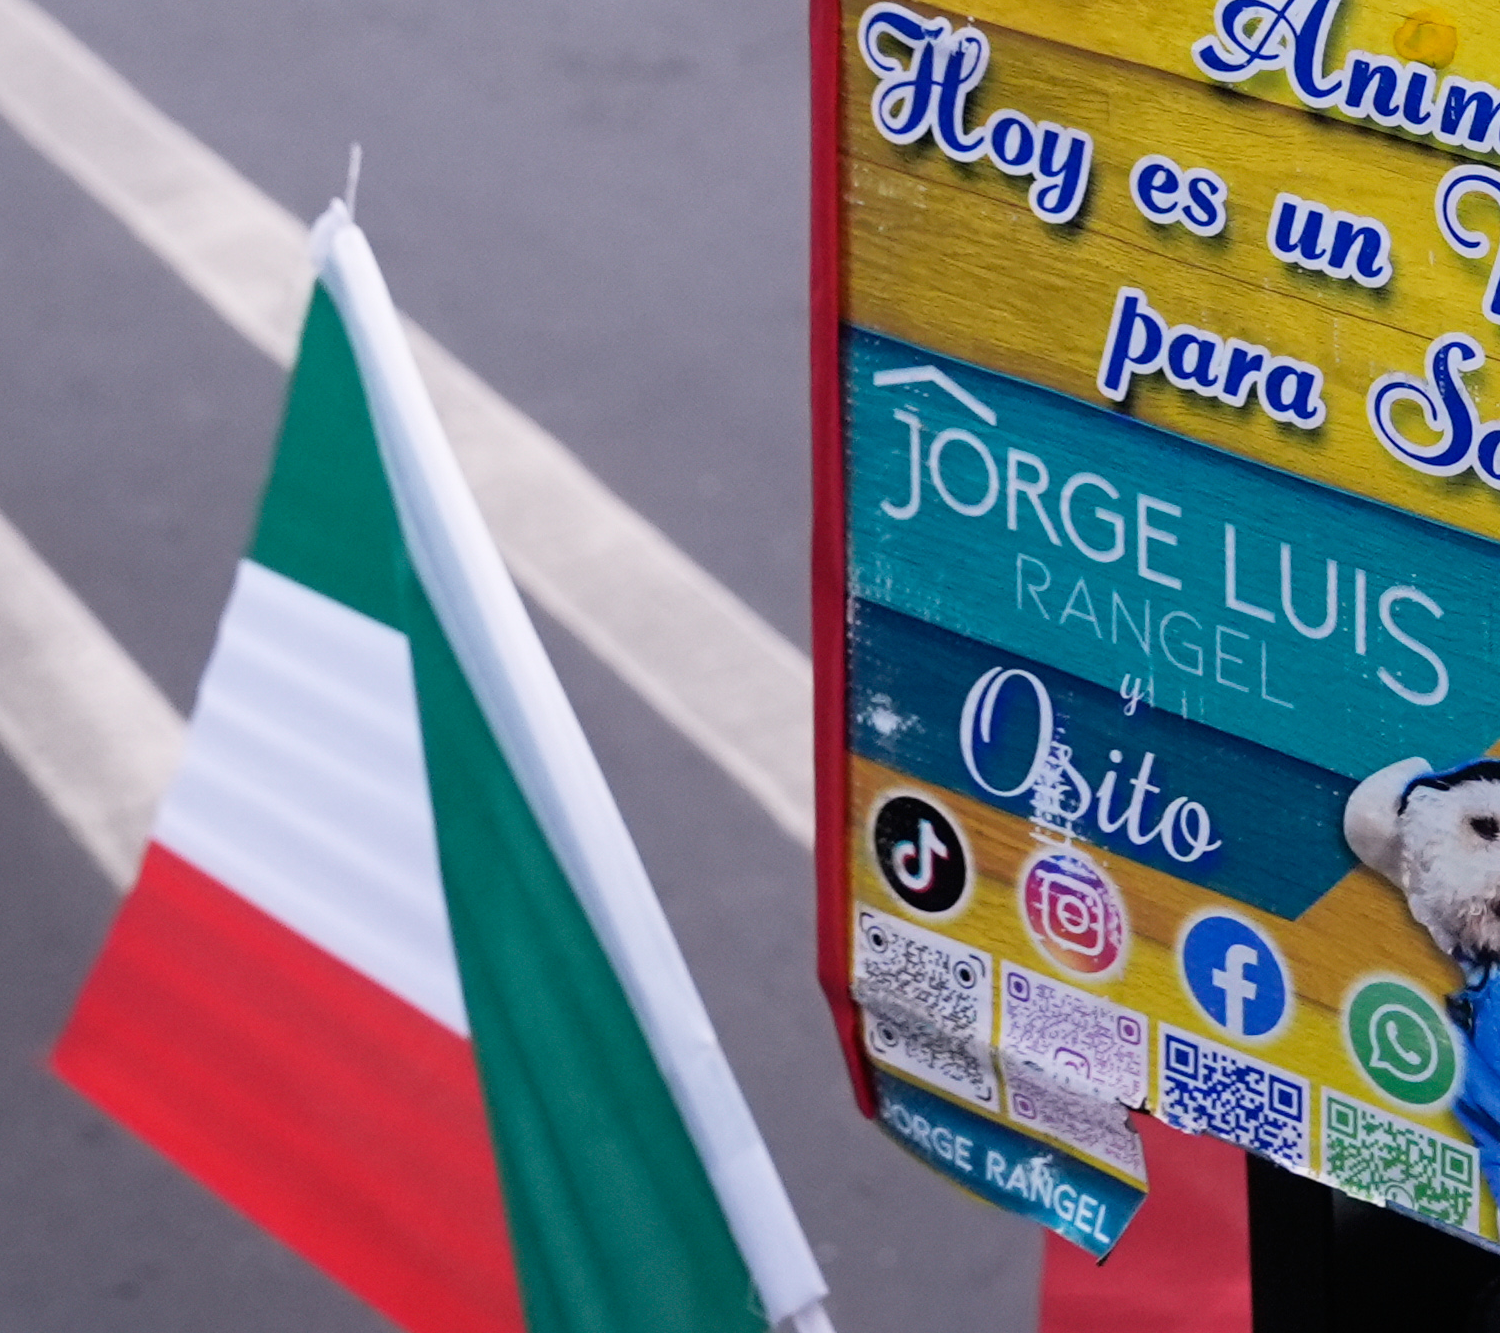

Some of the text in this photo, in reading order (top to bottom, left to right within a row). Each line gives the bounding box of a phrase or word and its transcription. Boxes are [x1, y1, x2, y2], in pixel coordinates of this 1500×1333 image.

[861, 5, 1090, 220] Hoy
[1133, 159, 1222, 231] es
[1274, 197, 1386, 283] un
[1101, 291, 1322, 425] para
[879, 406, 1451, 706] JORGE LUIS
[1014, 552, 1294, 710] RANGEL
[958, 665, 1222, 865] Osito
[985, 1150, 1110, 1244] RANGEL
